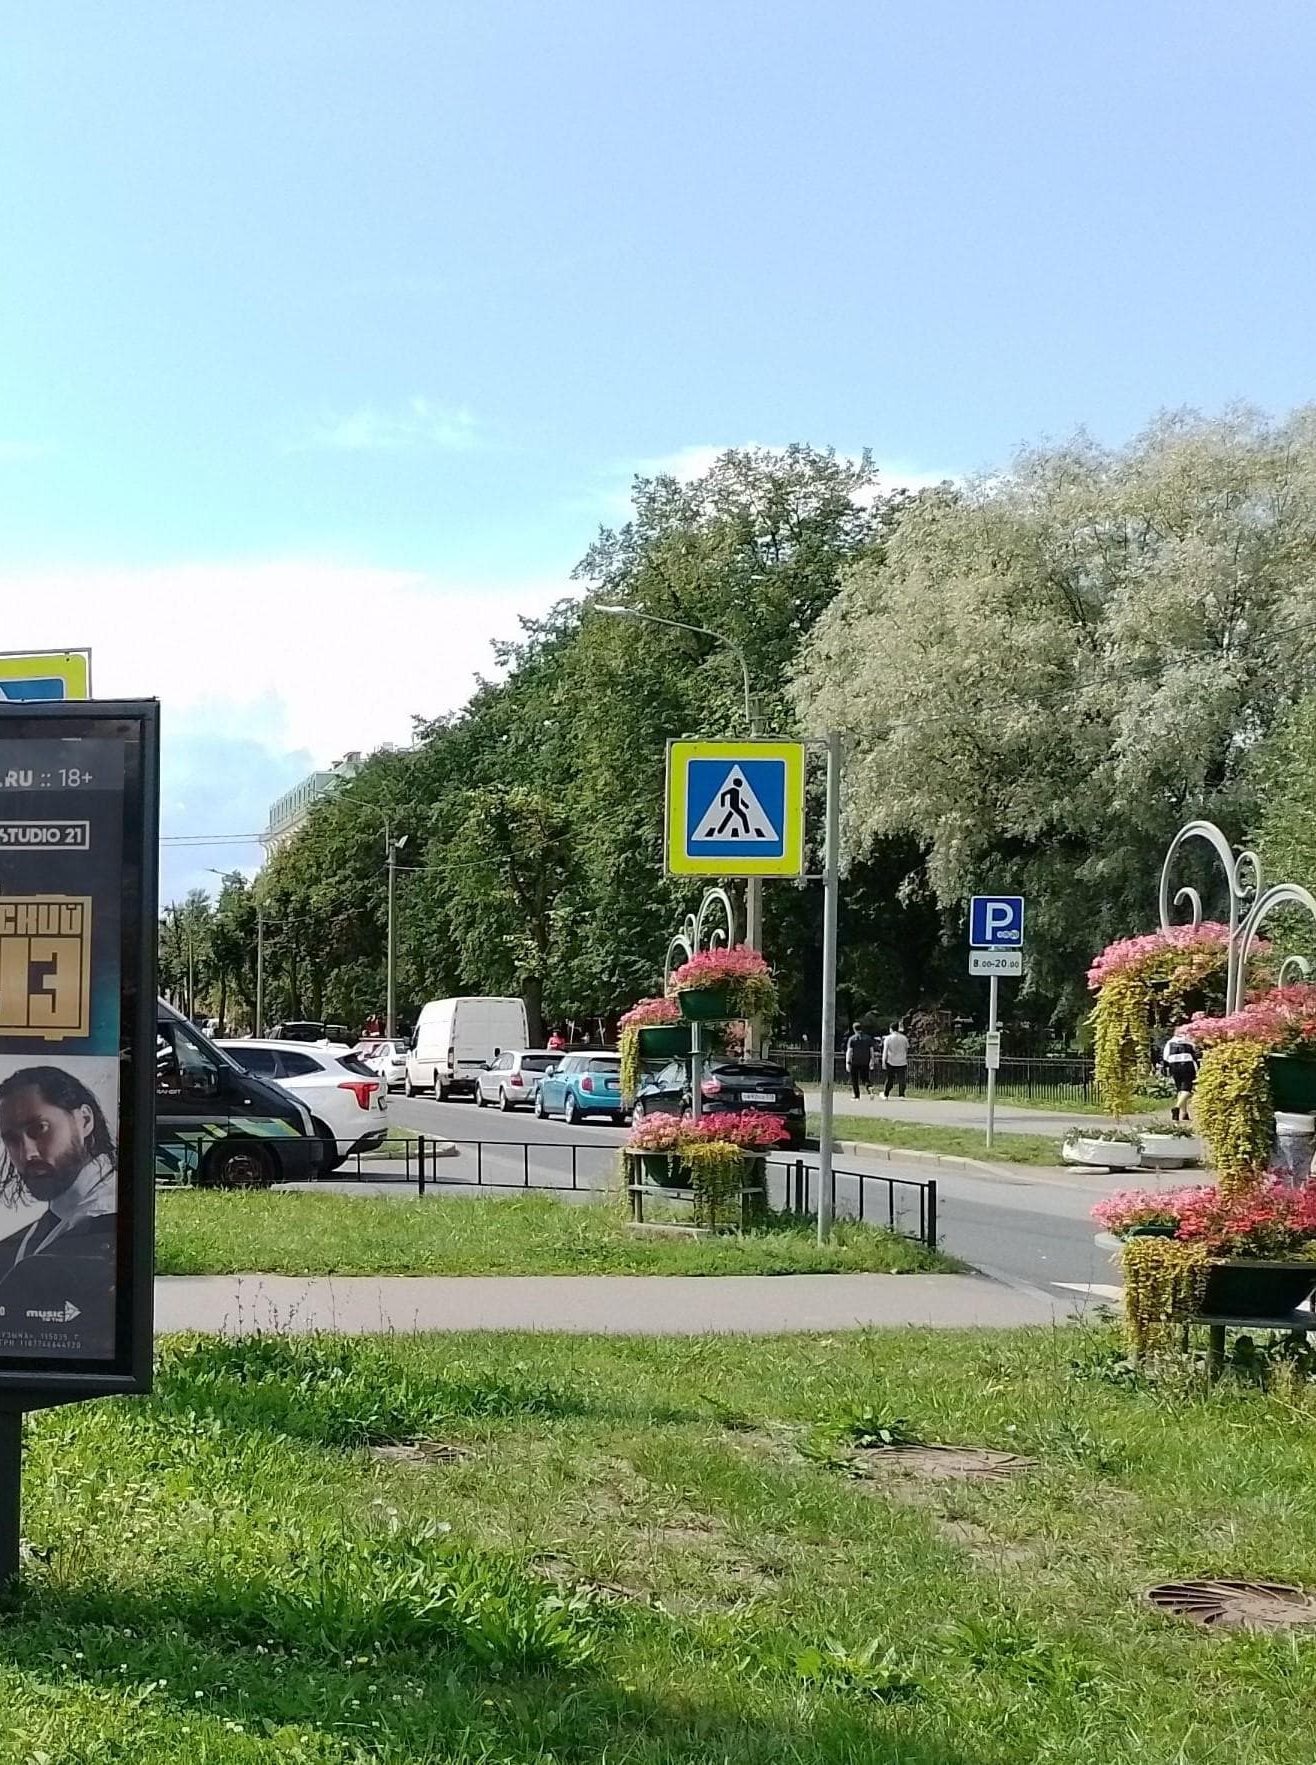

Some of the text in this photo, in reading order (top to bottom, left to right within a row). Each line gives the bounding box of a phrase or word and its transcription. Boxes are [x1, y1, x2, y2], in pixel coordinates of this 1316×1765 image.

[58, 768, 93, 788] 18+
[64, 827, 82, 843] 21
[985, 902, 1014, 940] P
